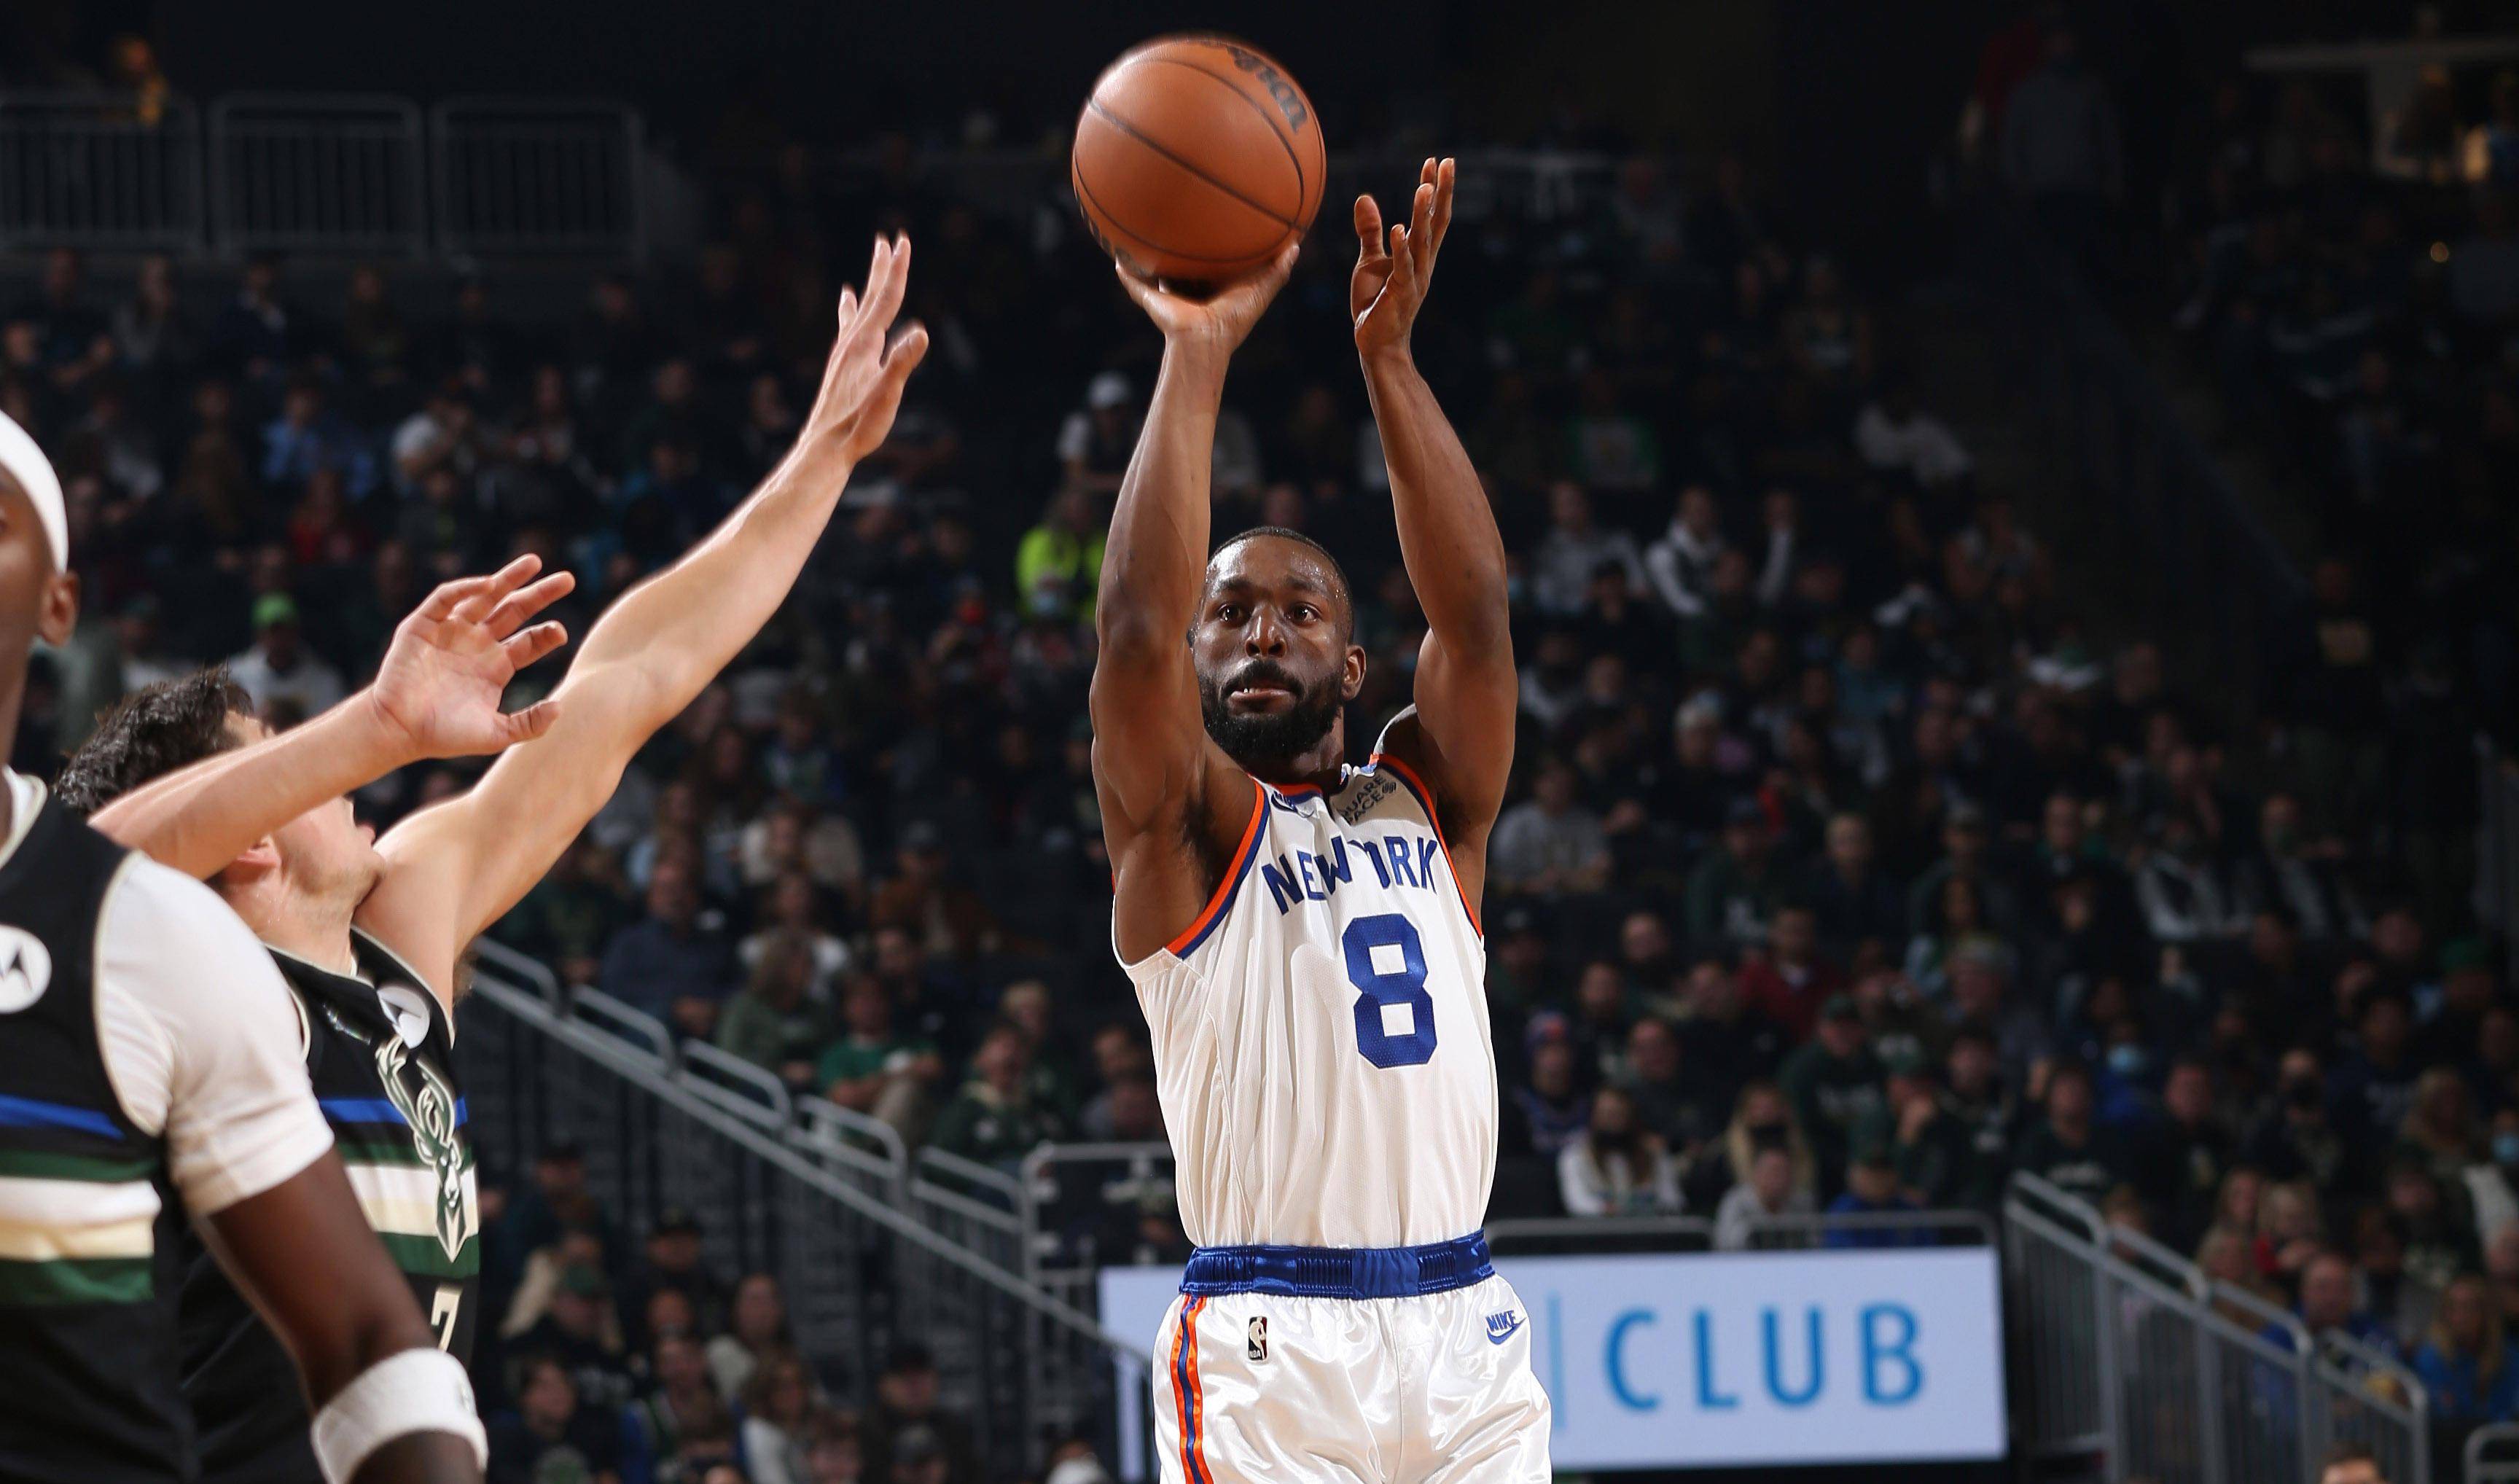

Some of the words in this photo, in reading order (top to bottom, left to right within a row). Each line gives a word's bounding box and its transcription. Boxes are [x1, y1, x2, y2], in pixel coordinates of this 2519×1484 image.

[1261, 835, 1353, 916] NEW
[1342, 913, 1437, 1069] 8
[431, 1286, 463, 1353] 7
[1485, 1310, 1518, 1332] NIKE
[1602, 1302, 1926, 1414] CLUB
